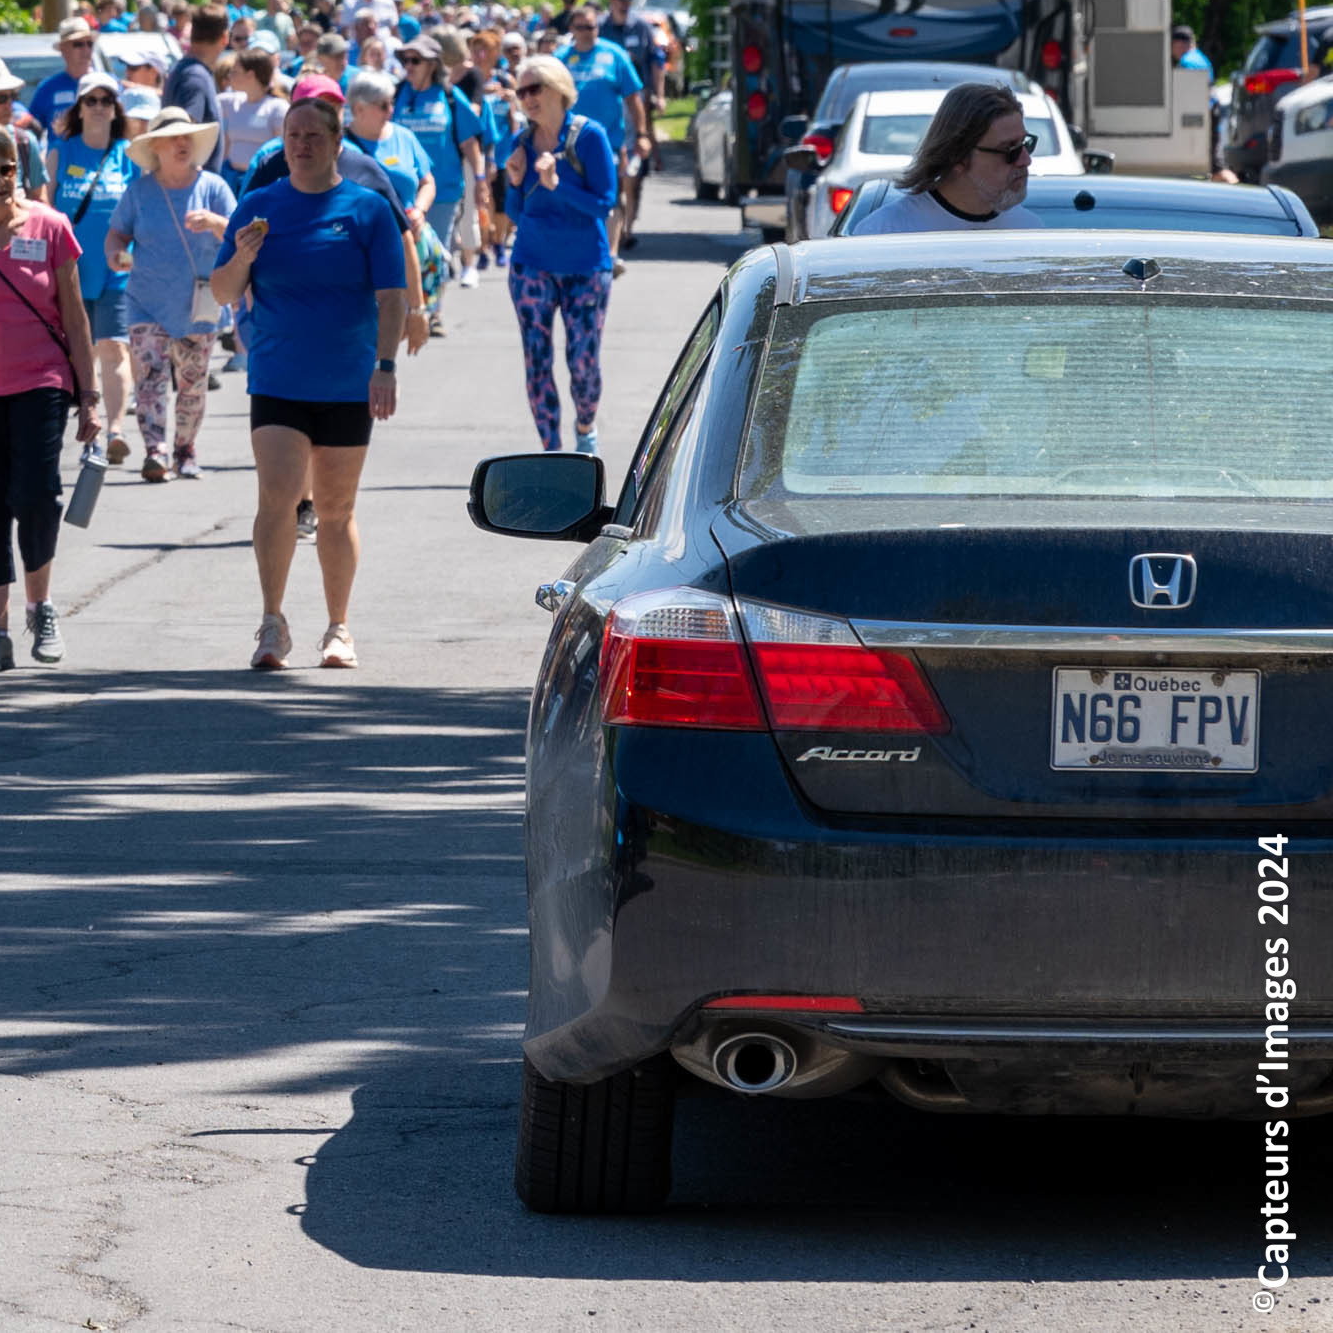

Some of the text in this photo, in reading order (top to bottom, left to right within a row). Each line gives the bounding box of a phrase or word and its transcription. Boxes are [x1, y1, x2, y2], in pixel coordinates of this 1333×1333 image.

[1133, 676, 1201, 692] Québec
[1061, 693, 1249, 746] N66 FPV
[796, 746, 921, 762] Accord
